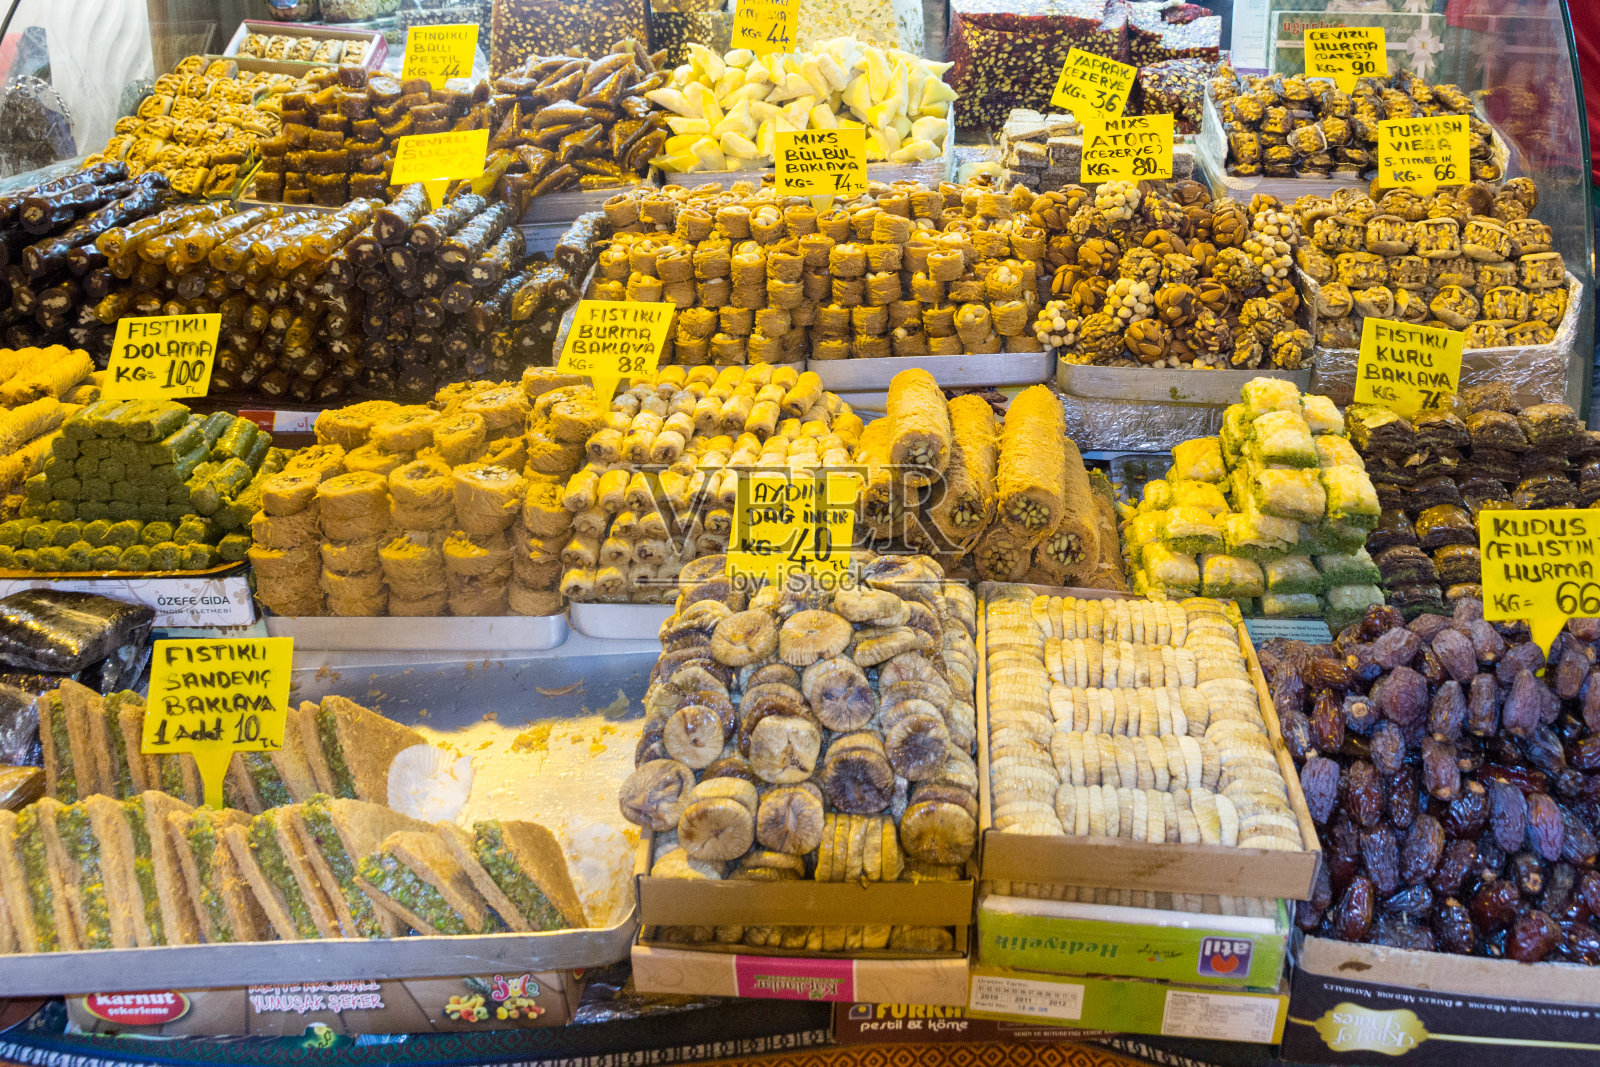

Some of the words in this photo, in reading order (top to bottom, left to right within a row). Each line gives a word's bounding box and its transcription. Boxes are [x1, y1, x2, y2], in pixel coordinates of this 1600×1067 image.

[766, 23, 790, 44] 44
[414, 43, 451, 53] BALLI
[1314, 41, 1378, 52] HURMA
[439, 64, 460, 77] 44
[1074, 54, 1131, 80] YAPRAK
[1351, 60, 1376, 75] 90
[1090, 89, 1122, 113] 36
[1105, 118, 1150, 131] MIXS
[1385, 121, 1462, 138] TURKISH
[794, 132, 839, 145] MIXS
[1091, 132, 1162, 148] ATOM
[785, 162, 859, 174] BAKLAVA
[1132, 157, 1158, 176] 80
[1434, 164, 1456, 180] 66
[830, 173, 852, 191] 74
[590, 308, 662, 323] FISTIKLI
[128, 318, 207, 339] FISTIKLI
[578, 325, 651, 342] BURMA
[1375, 325, 1448, 350] FISTIKLI
[123, 340, 213, 359] DOLAMA
[572, 340, 656, 355] BAKLAVA
[1376, 345, 1434, 367] KURU
[160, 359, 206, 388] 100
[618, 356, 646, 373] 88
[1363, 363, 1453, 390] BAKLAVA
[754, 482, 825, 502] AYDIN
[1493, 518, 1587, 537] KUDUS
[787, 527, 832, 570] 40
[1485, 537, 1600, 560] (FILISTIN
[1504, 561, 1593, 582] HURMA
[157, 595, 197, 606] ÖZEFE
[201, 596, 231, 605] GIDA
[1493, 593, 1534, 612] KG=
[1556, 581, 1600, 614] 66
[165, 645, 266, 666] FISTIKLI
[162, 694, 276, 716] BAKLAVA
[152, 719, 170, 745] 1
[174, 717, 226, 741] Adet
[232, 713, 260, 744] 10
[995, 935, 1119, 957] Hediyelik
[249, 994, 327, 1014] YUMUŞAK
[328, 993, 385, 1013] ŞEKER
[876, 1003, 965, 1019] FURKA
[860, 1020, 903, 1032] pestil
[928, 1019, 969, 1032] köme
